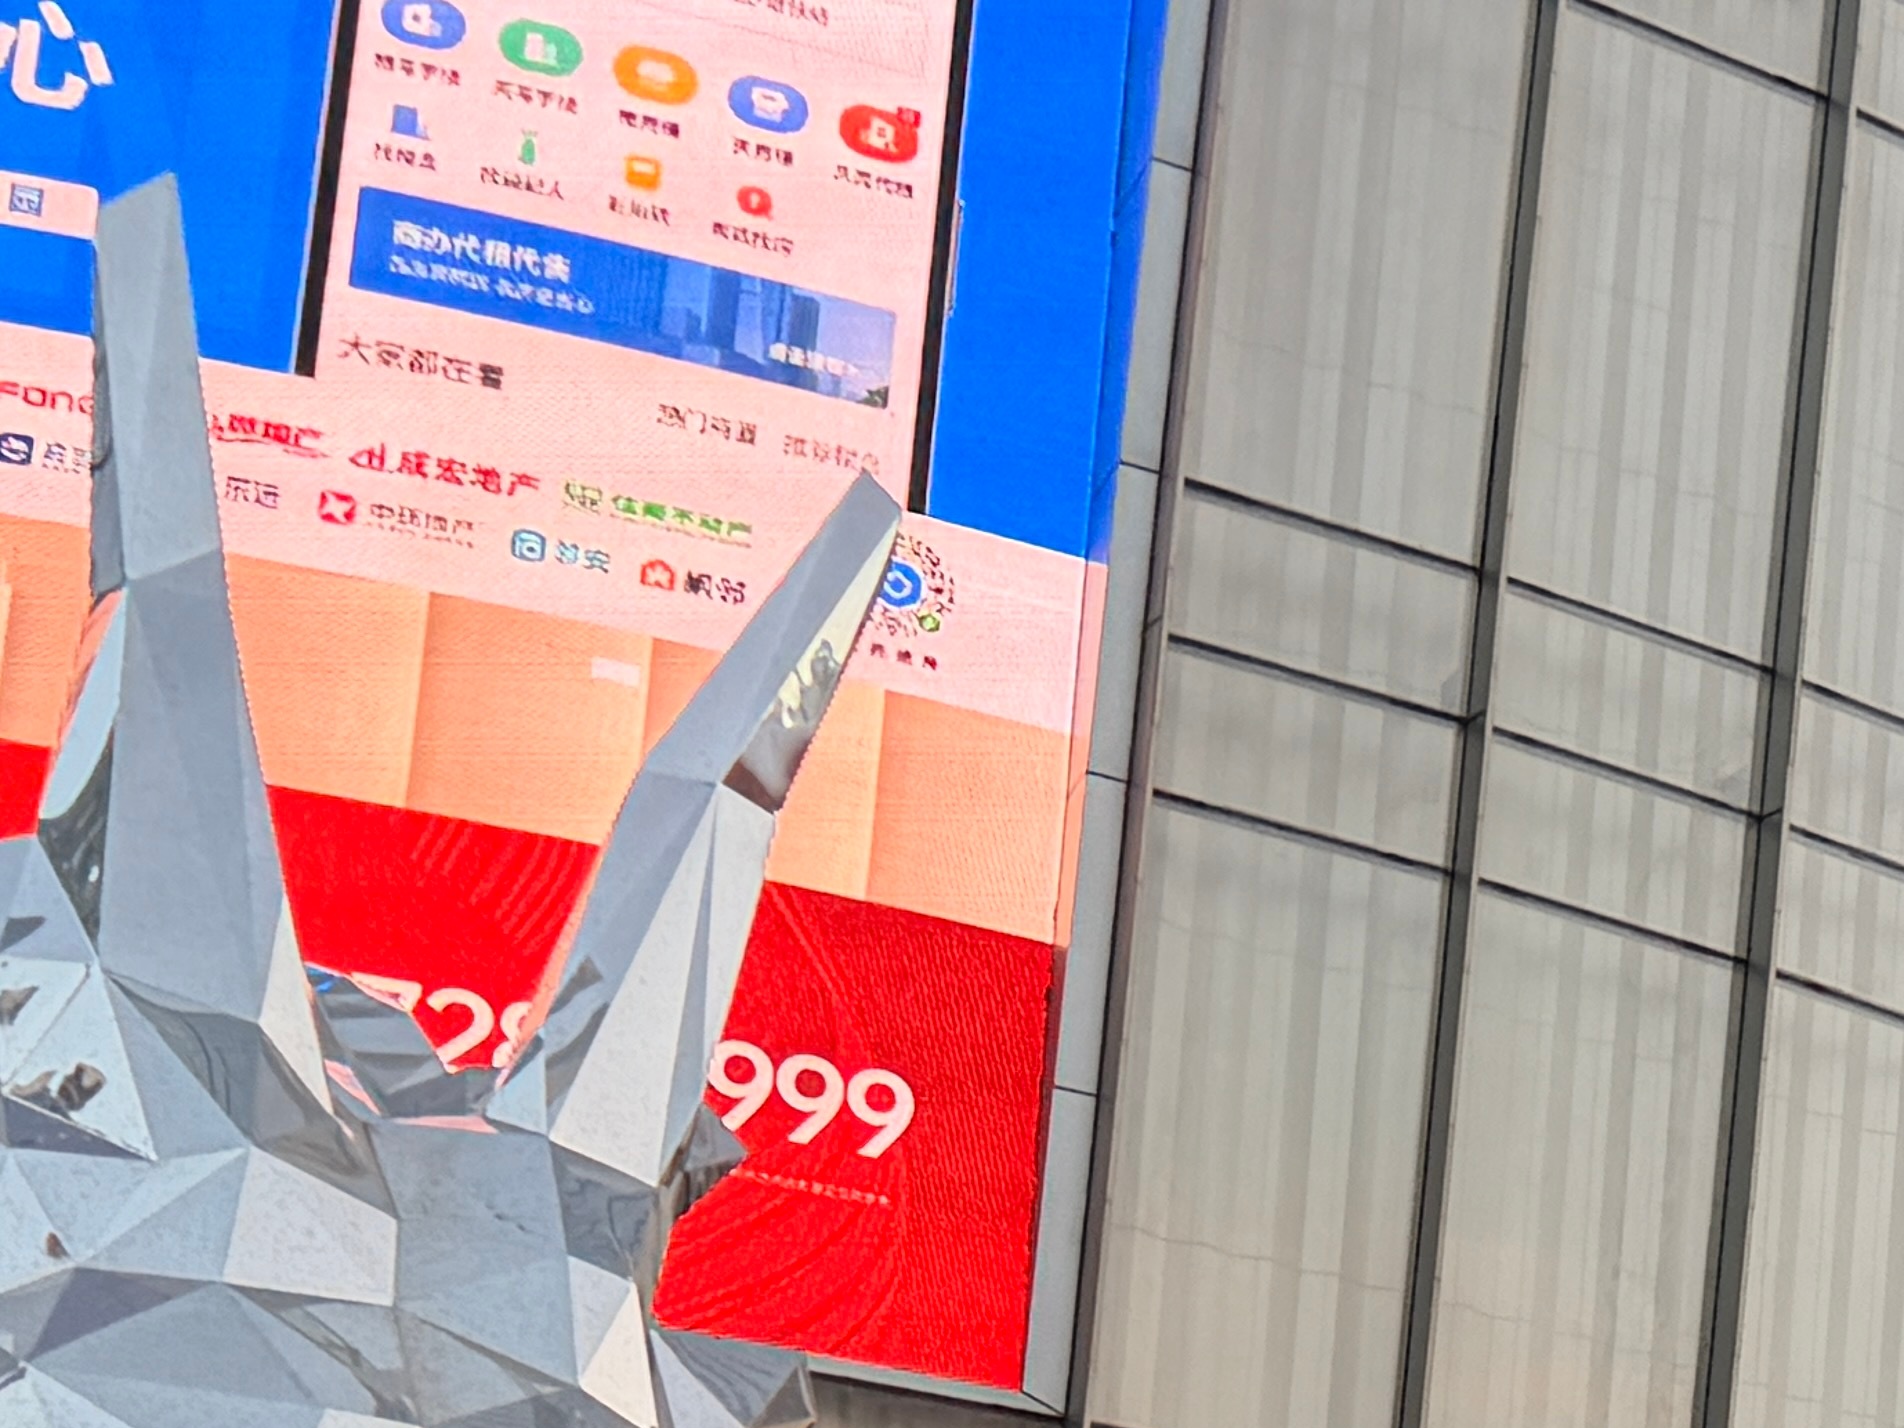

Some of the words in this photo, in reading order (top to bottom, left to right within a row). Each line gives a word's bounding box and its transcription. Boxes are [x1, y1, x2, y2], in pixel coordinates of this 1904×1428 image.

[0, 0, 115, 110] 心
[337, 332, 504, 391] 大家都在看
